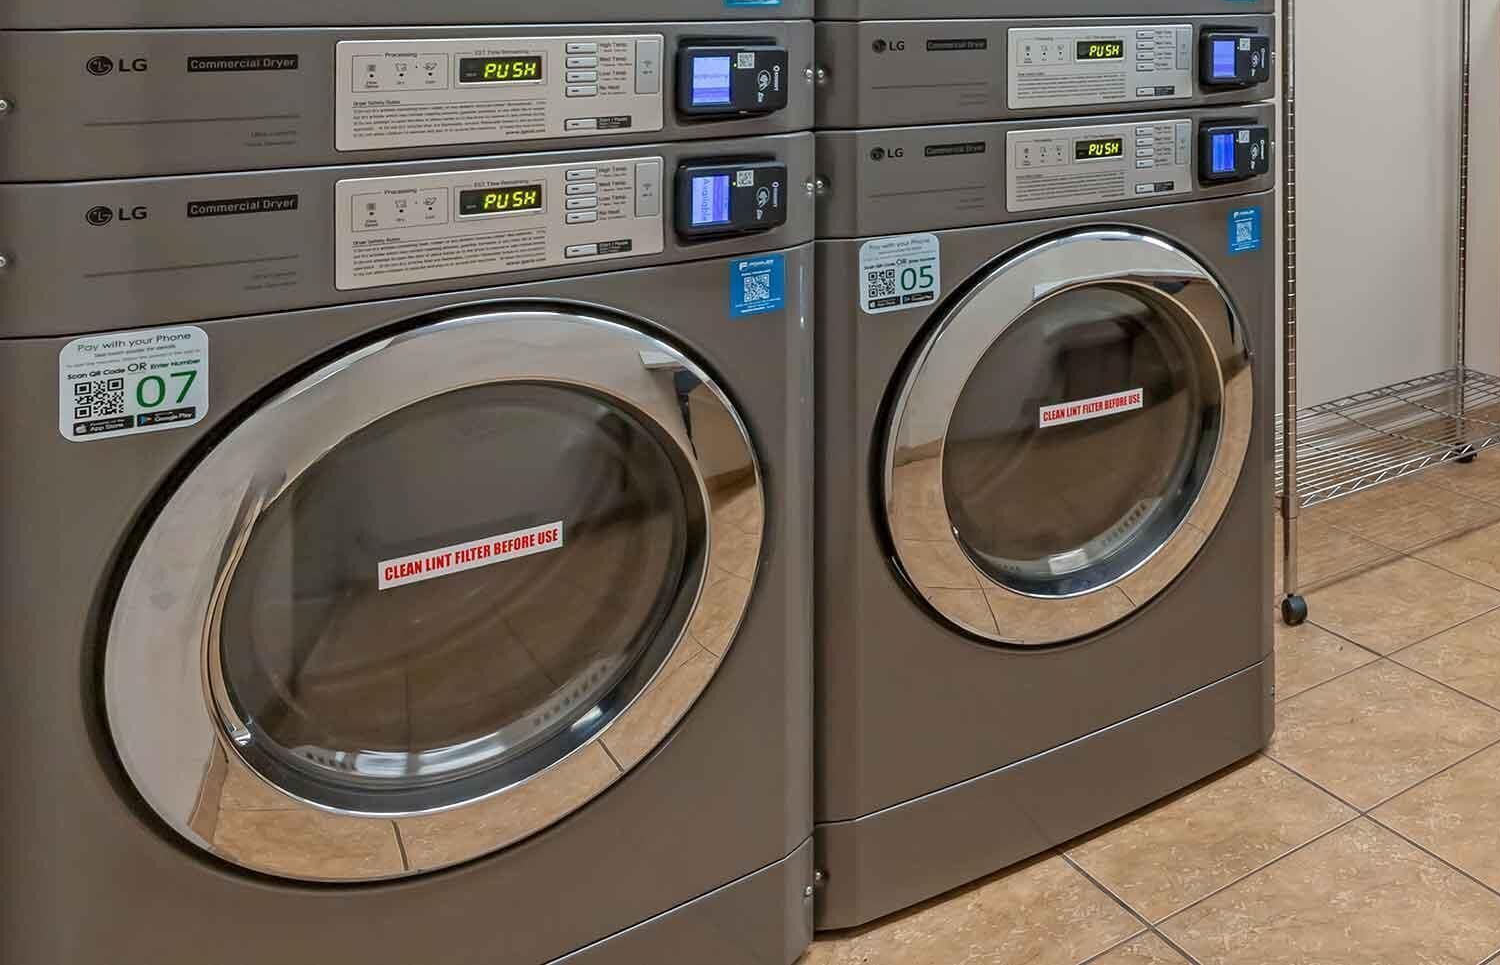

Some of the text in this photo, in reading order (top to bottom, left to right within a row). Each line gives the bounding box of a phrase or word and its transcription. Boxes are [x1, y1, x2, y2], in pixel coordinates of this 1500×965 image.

[889, 40, 904, 51] LG
[1088, 44, 1120, 56] PUSH
[118, 58, 148, 72] LG
[190, 57, 296, 70] Commercial Dryer
[484, 62, 536, 78] PUSH
[888, 148, 904, 158] LG
[1088, 142, 1119, 156] PUSH
[190, 198, 295, 215] Commercial Dryer
[484, 191, 536, 209] PUSH
[118, 206, 148, 221] LG
[900, 265, 934, 290] 05
[77, 333, 192, 352] Pay with your Phone
[128, 363, 147, 372] OR
[170, 358, 200, 366] Number
[136, 370, 198, 408] 07
[1043, 394, 1140, 422] CLEAN LINT FILTER BEFORE USE
[384, 528, 558, 581] CLEAN LINT FILTER BEFORE USE
